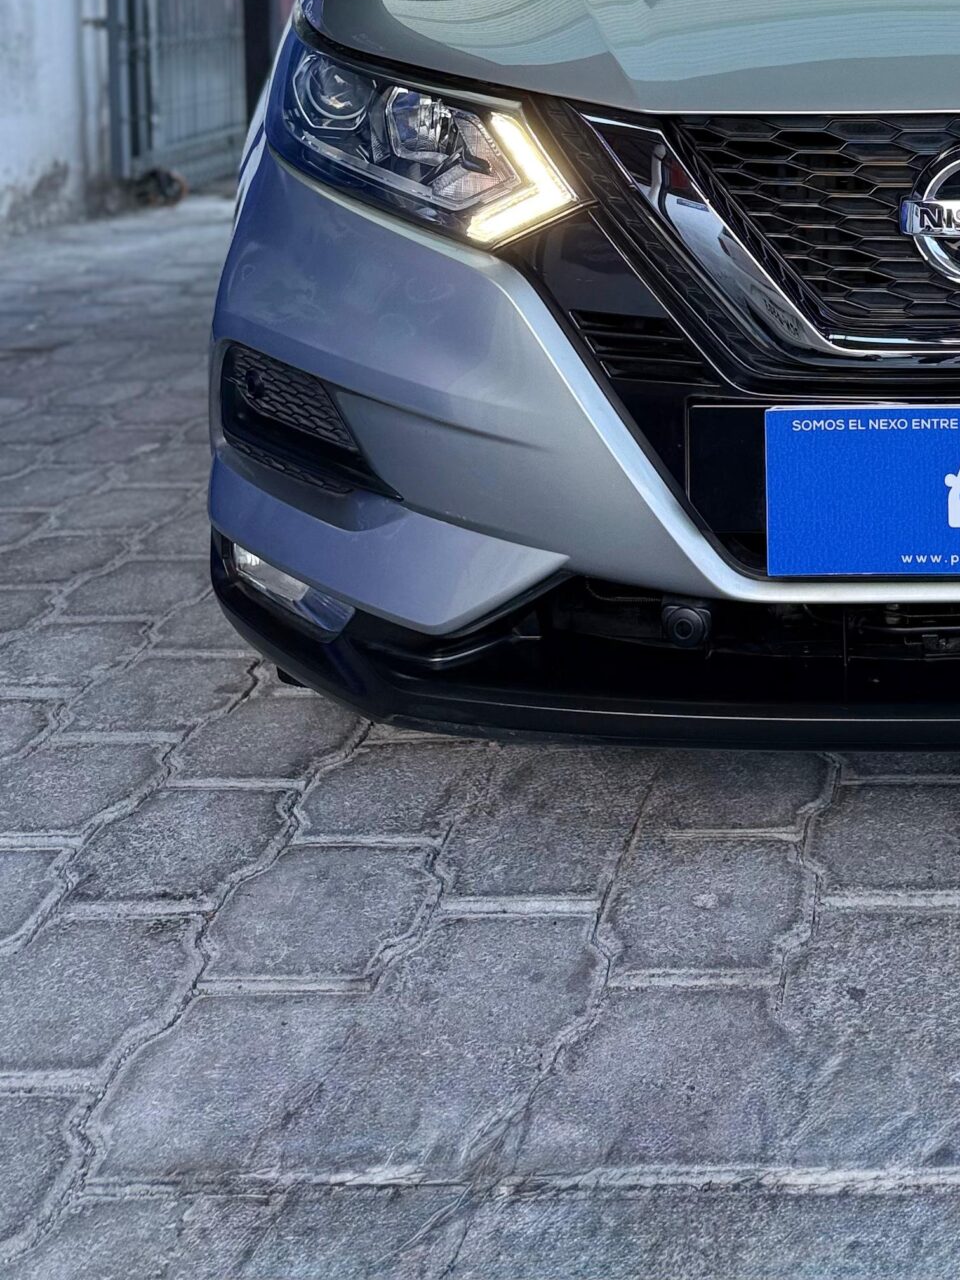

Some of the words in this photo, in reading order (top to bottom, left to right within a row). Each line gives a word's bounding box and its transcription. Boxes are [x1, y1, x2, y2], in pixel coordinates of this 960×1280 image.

[792, 419, 845, 432] SOMOS
[848, 419, 866, 431] EL
[868, 419, 908, 431] NEXO
[911, 418, 959, 430] ENTRE
